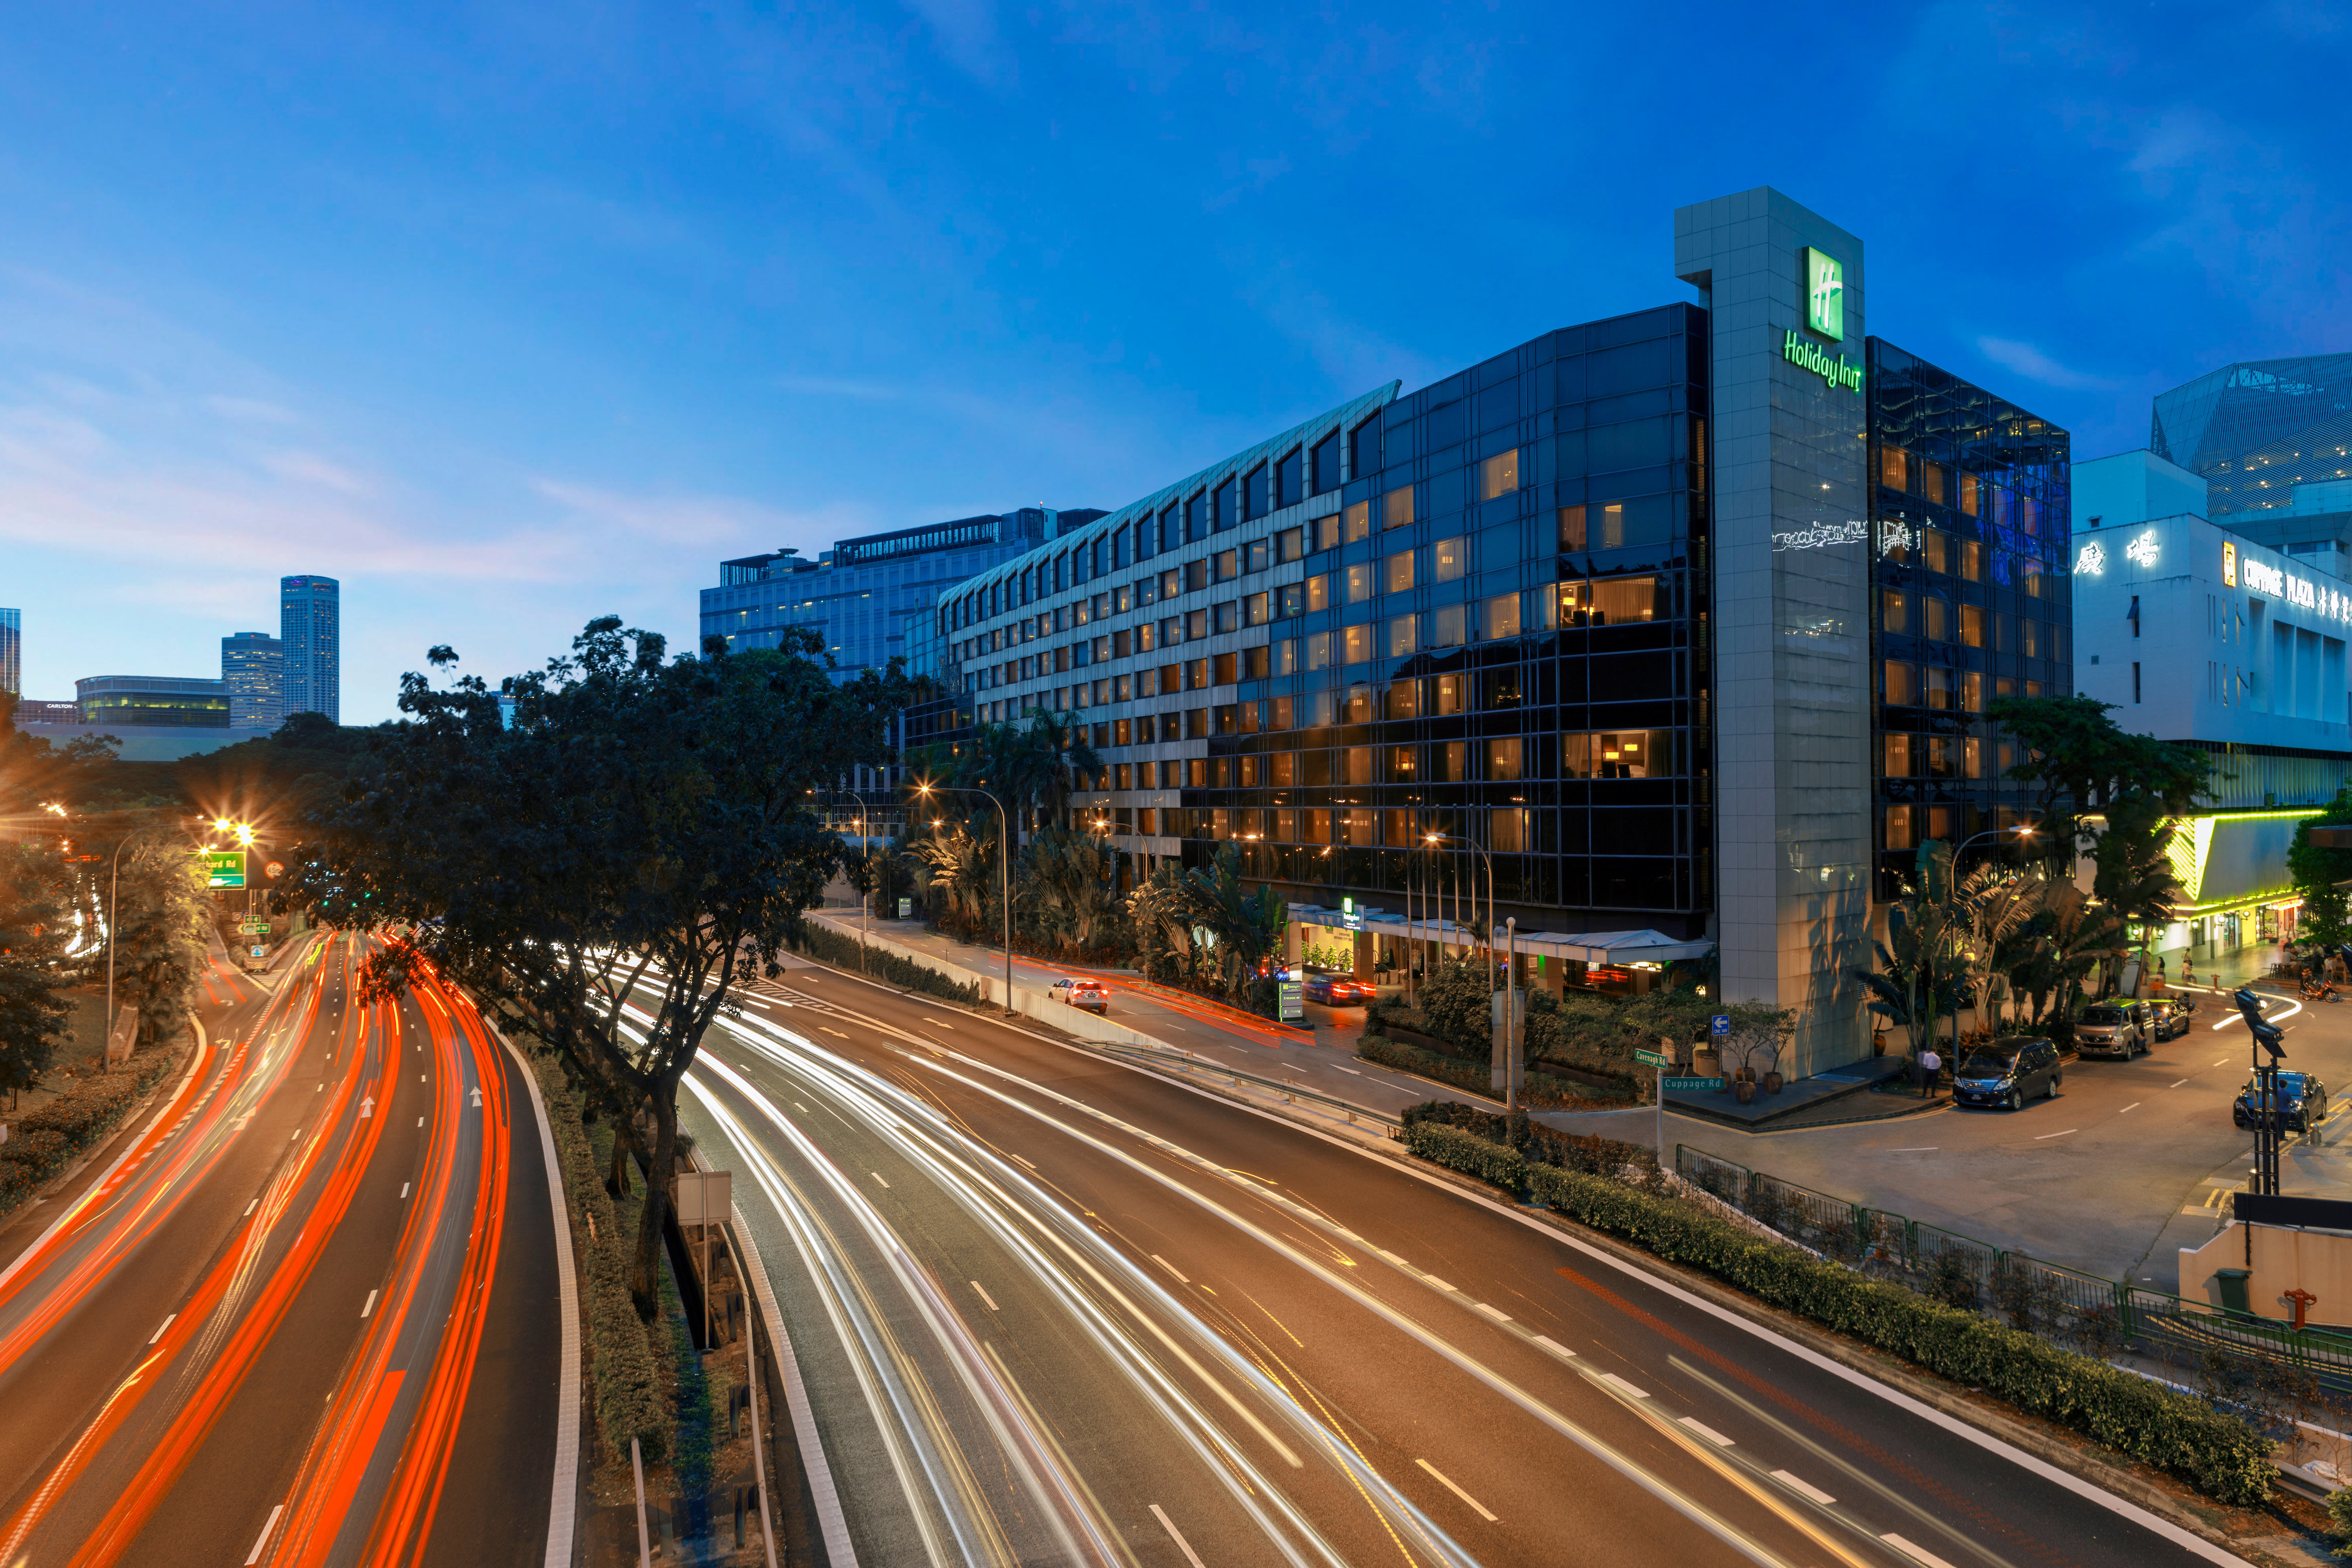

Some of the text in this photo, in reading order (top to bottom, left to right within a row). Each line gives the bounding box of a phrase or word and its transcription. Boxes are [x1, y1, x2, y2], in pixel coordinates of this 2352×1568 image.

[1784, 329, 1860, 390] Holiday Inn
[2286, 575, 2315, 609] PLAZA
[1637, 1051, 1665, 1066] Cavenagh Rd
[1665, 1079, 1720, 1089] Cuppage Rd
